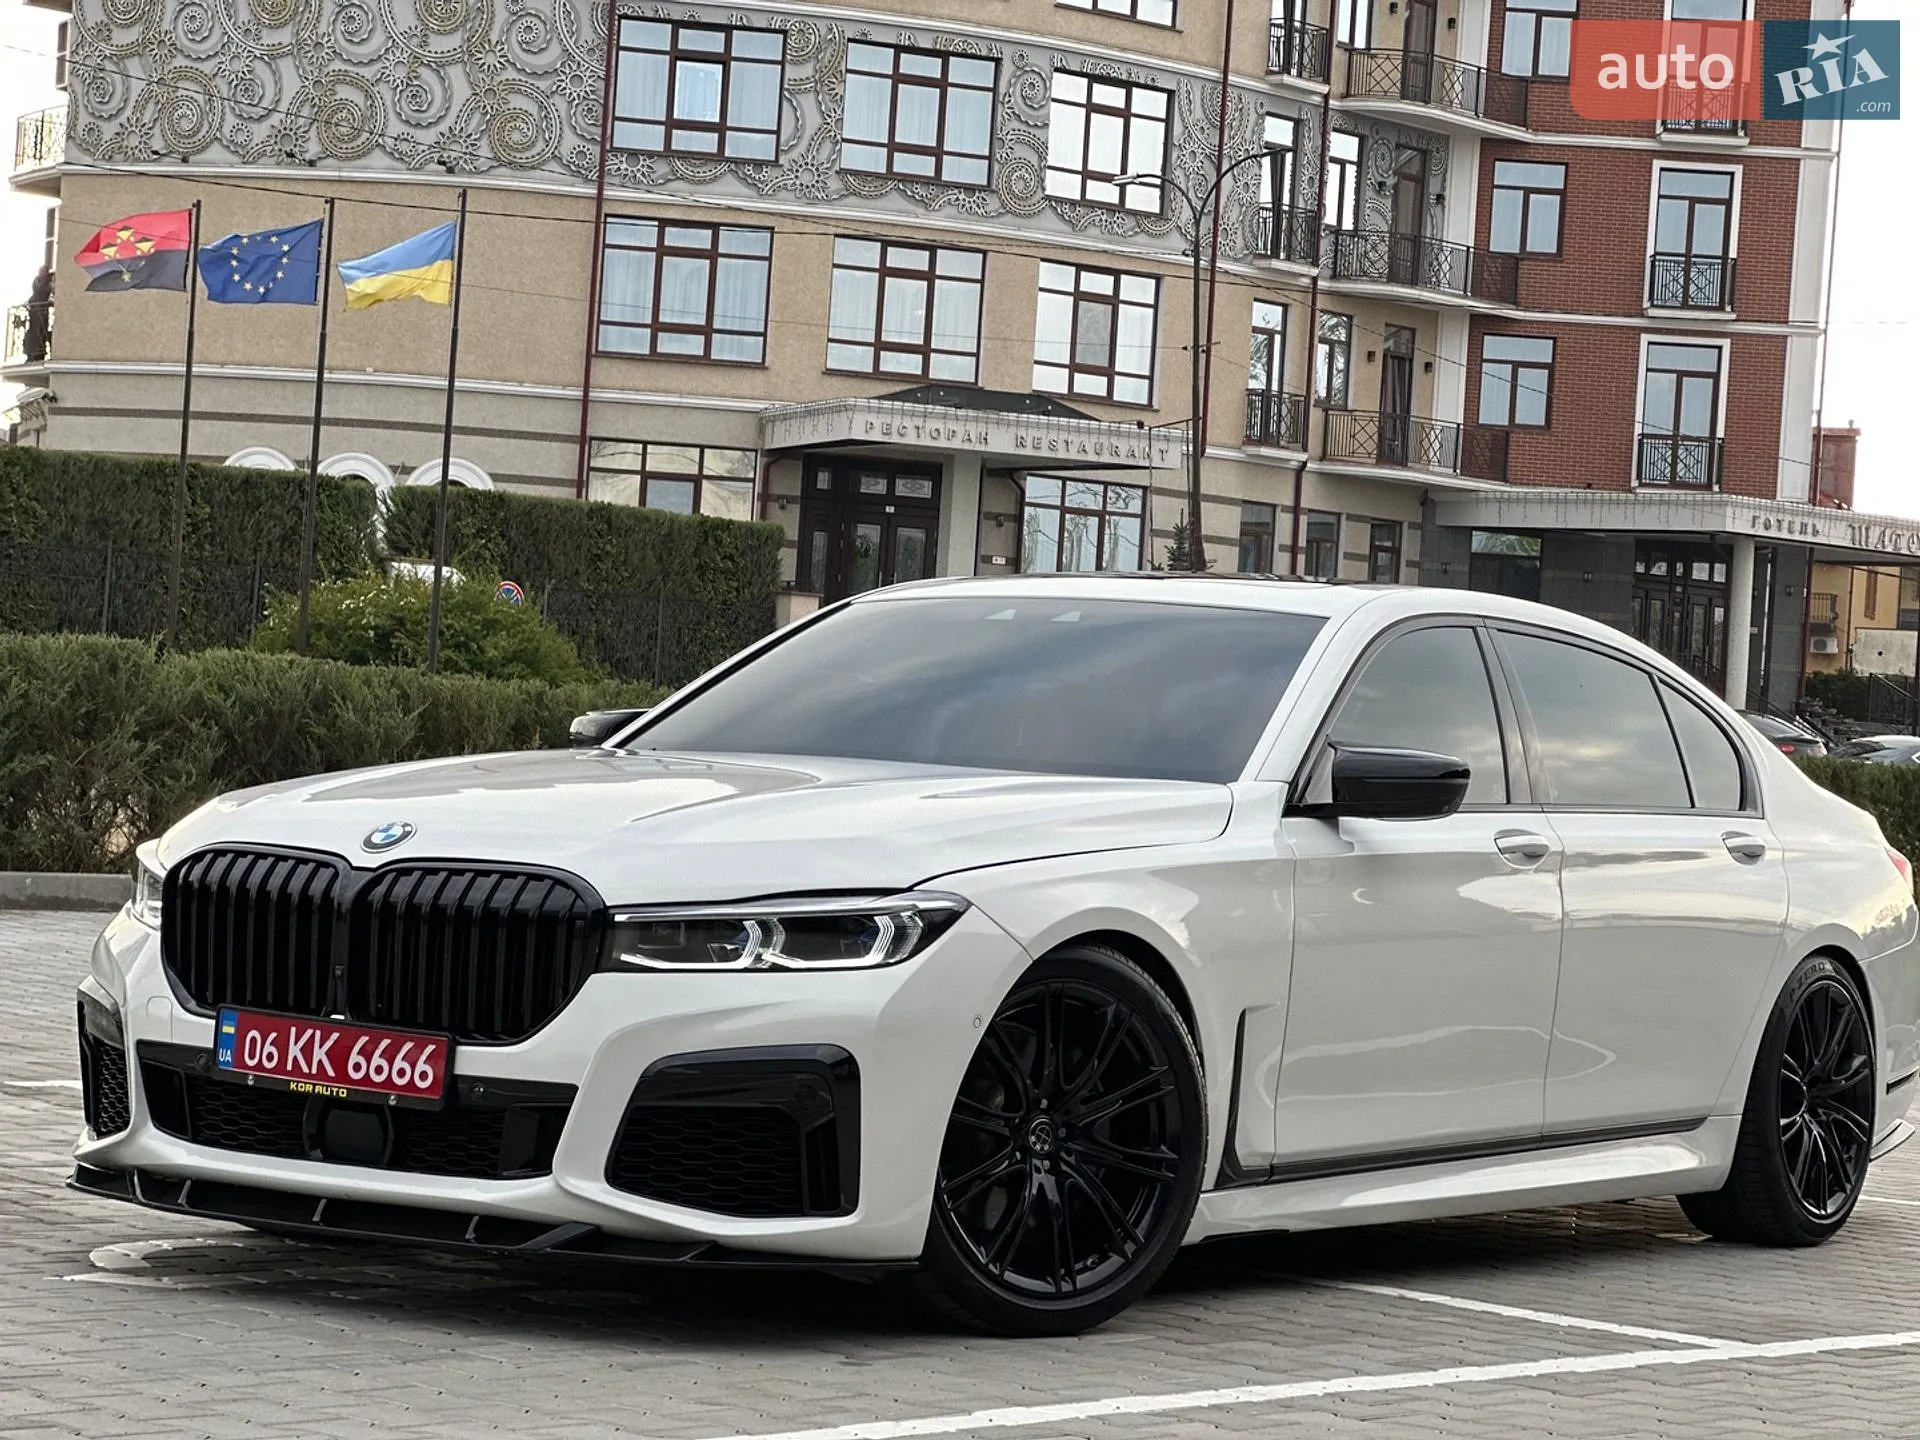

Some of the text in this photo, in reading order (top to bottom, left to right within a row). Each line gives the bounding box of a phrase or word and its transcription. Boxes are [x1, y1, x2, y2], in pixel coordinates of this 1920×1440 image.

[865, 418, 990, 446] РЕСТОРАН
[1015, 431, 1169, 461] RESTAURANT
[218, 1048, 232, 1063] UA
[244, 1026, 436, 1089] 06 KK 6666
[290, 1081, 347, 1098] KOR AUTO
